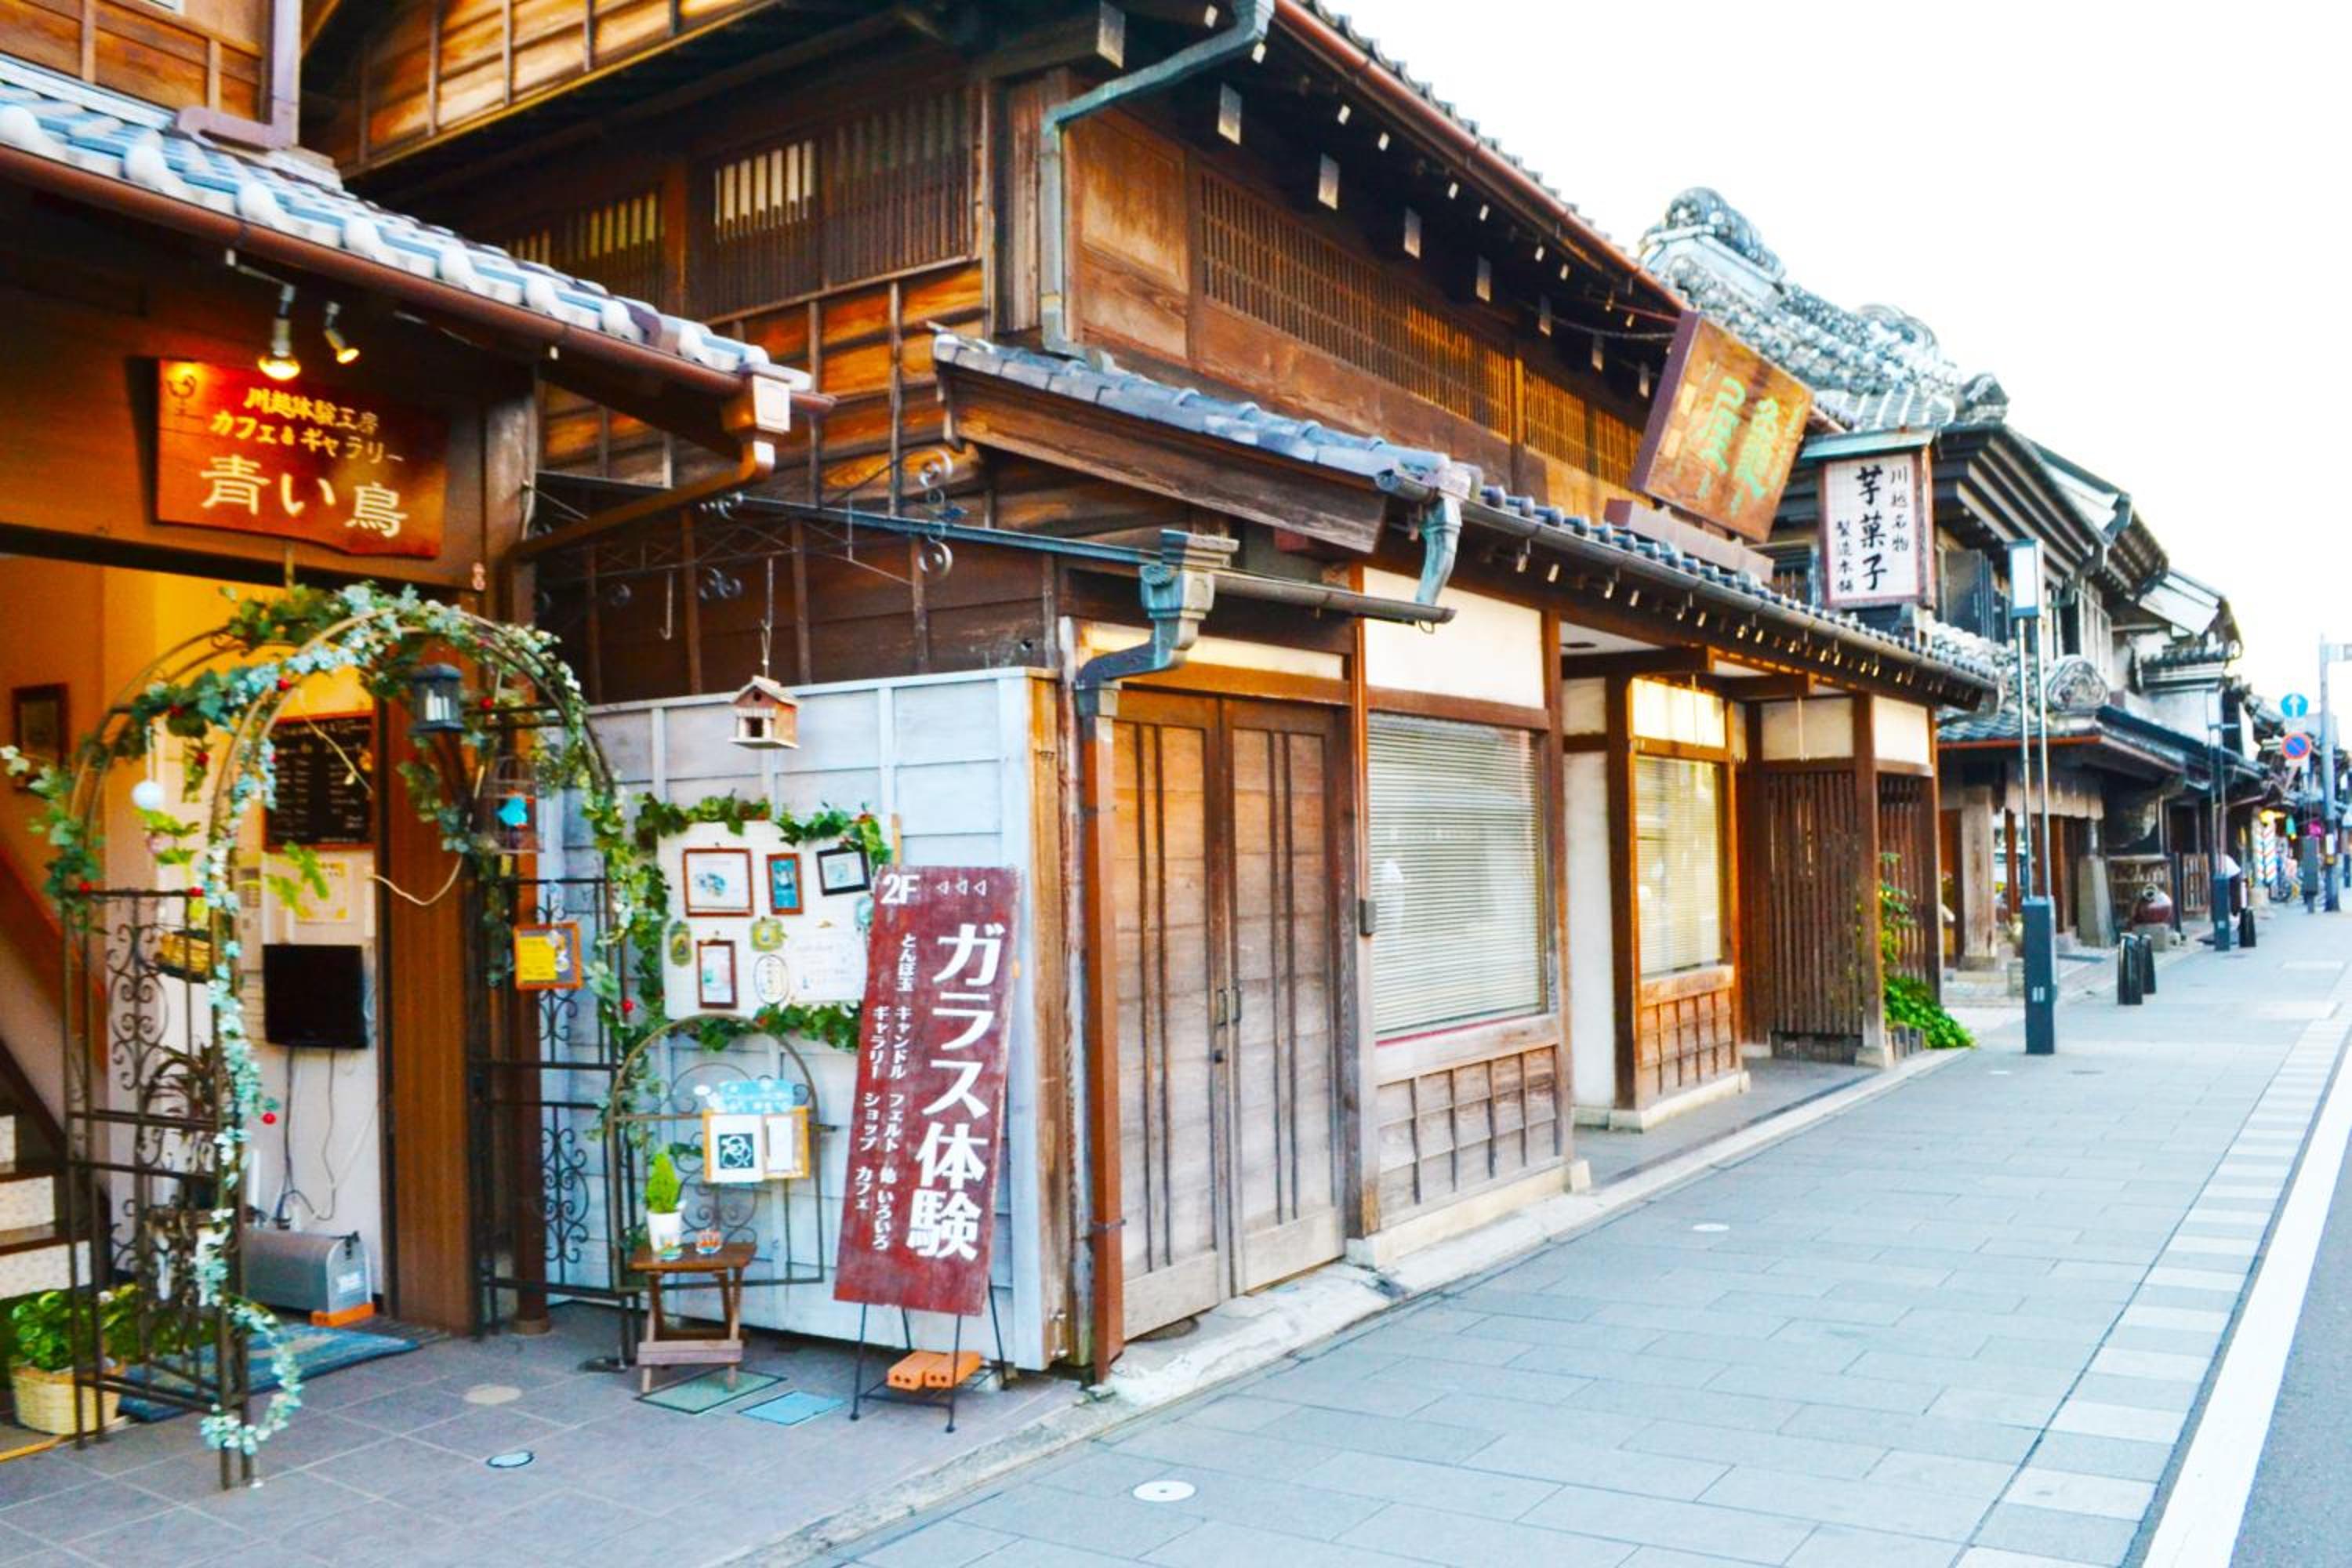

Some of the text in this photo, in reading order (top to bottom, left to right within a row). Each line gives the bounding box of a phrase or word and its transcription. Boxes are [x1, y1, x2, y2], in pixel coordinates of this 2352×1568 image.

[200, 454, 409, 538] 青い鳥
[1856, 465, 1887, 590] 芋菓子
[880, 873, 920, 904] 2F
[890, 1006, 913, 1080] キャンドル
[855, 1006, 890, 1210] ギャラリー ショップ カフェ
[884, 1093, 904, 1152] フェルト
[906, 923, 1005, 1261] ガラス体験
[872, 1189, 895, 1250] いろいろ
